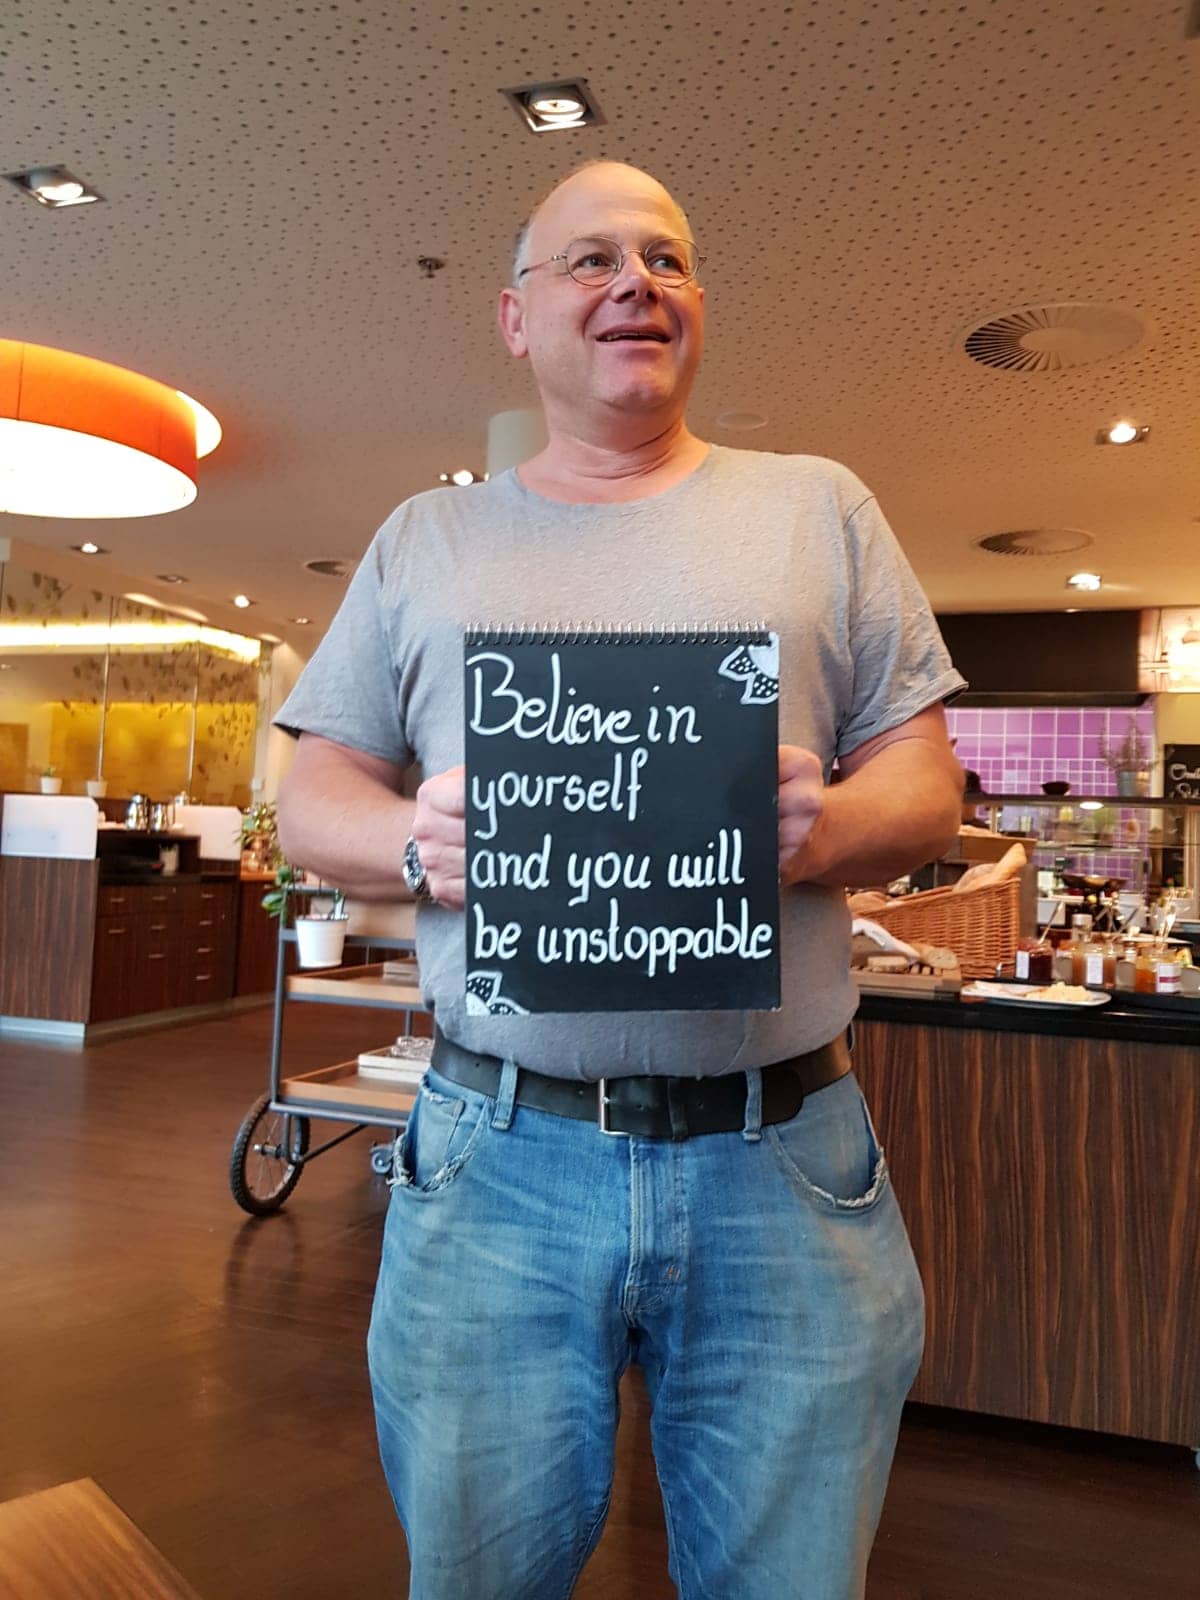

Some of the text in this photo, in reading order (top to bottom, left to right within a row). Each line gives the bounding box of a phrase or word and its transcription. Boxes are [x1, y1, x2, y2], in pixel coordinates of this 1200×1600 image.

[466, 652, 702, 745] Believe in
[472, 747, 649, 840] yourself
[470, 828, 745, 907] and you will
[473, 896, 773, 977] be unstoppable
